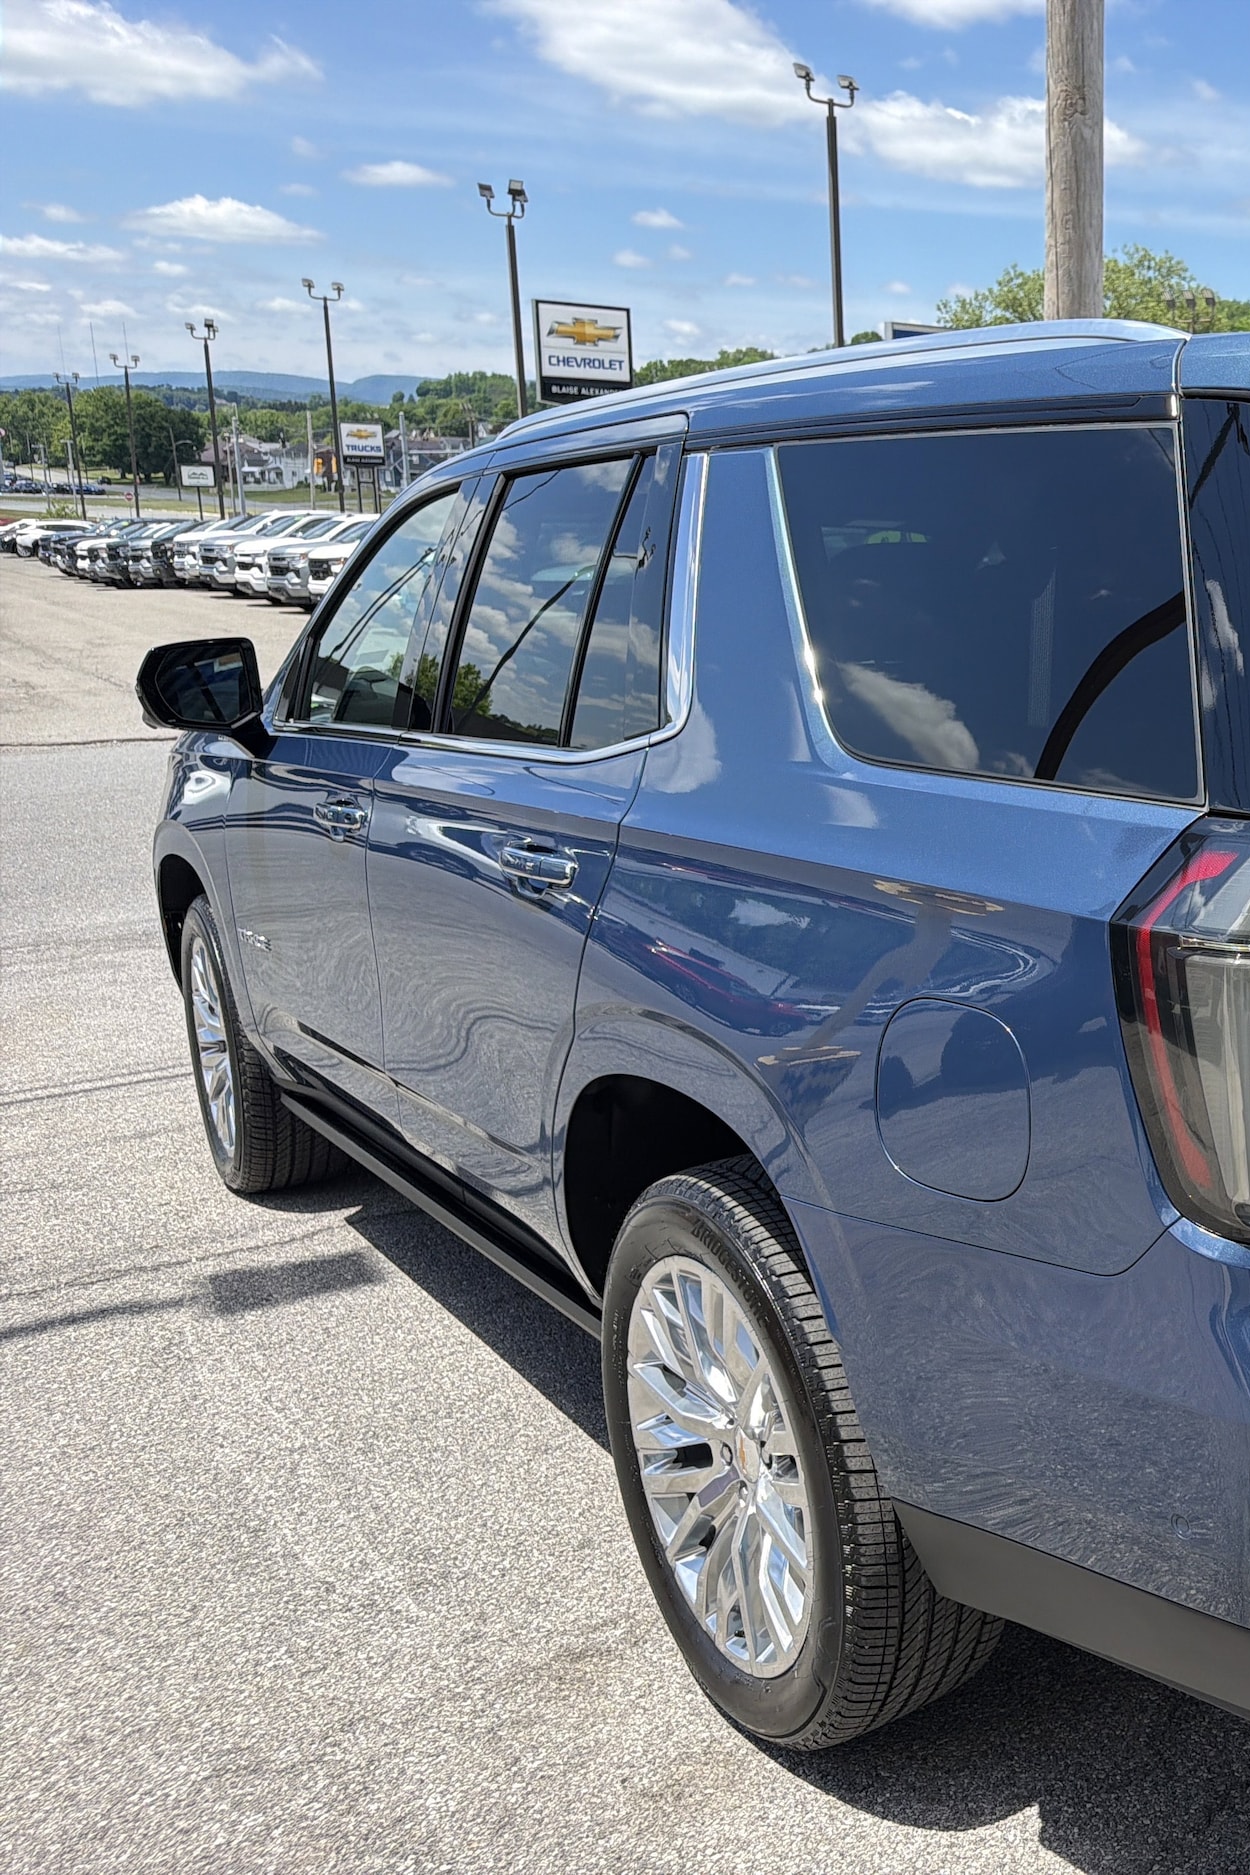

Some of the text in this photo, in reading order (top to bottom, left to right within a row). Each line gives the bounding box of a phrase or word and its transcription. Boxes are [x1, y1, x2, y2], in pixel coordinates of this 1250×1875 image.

[548, 355, 625, 371] CHEVROLET
[551, 384, 579, 396] BLAISE
[345, 444, 382, 453] TRUCKS
